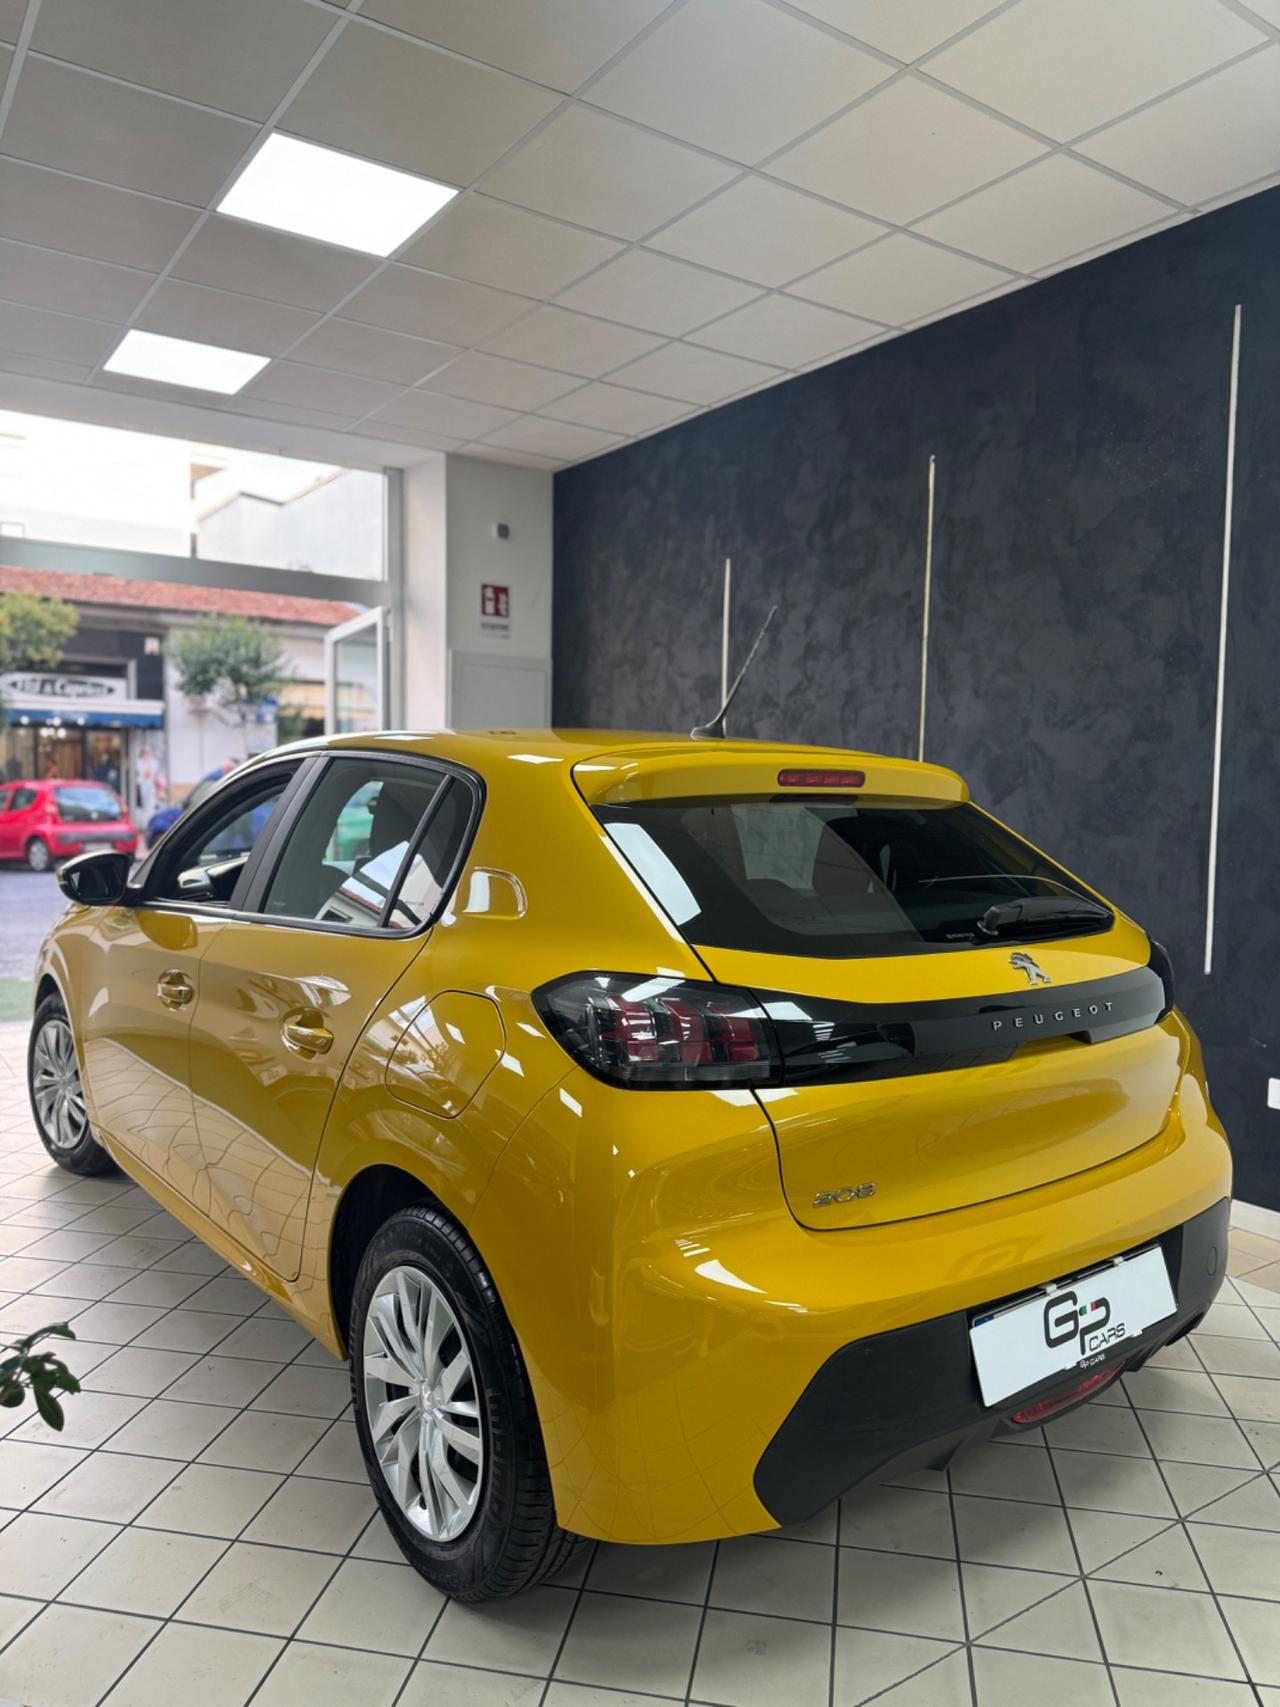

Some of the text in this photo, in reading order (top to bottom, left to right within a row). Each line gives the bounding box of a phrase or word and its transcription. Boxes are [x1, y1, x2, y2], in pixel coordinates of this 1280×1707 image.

[992, 1001, 1113, 1031] PEUGEOT
[812, 1182, 876, 1209] 208
[1088, 1322, 1126, 1352] CARS
